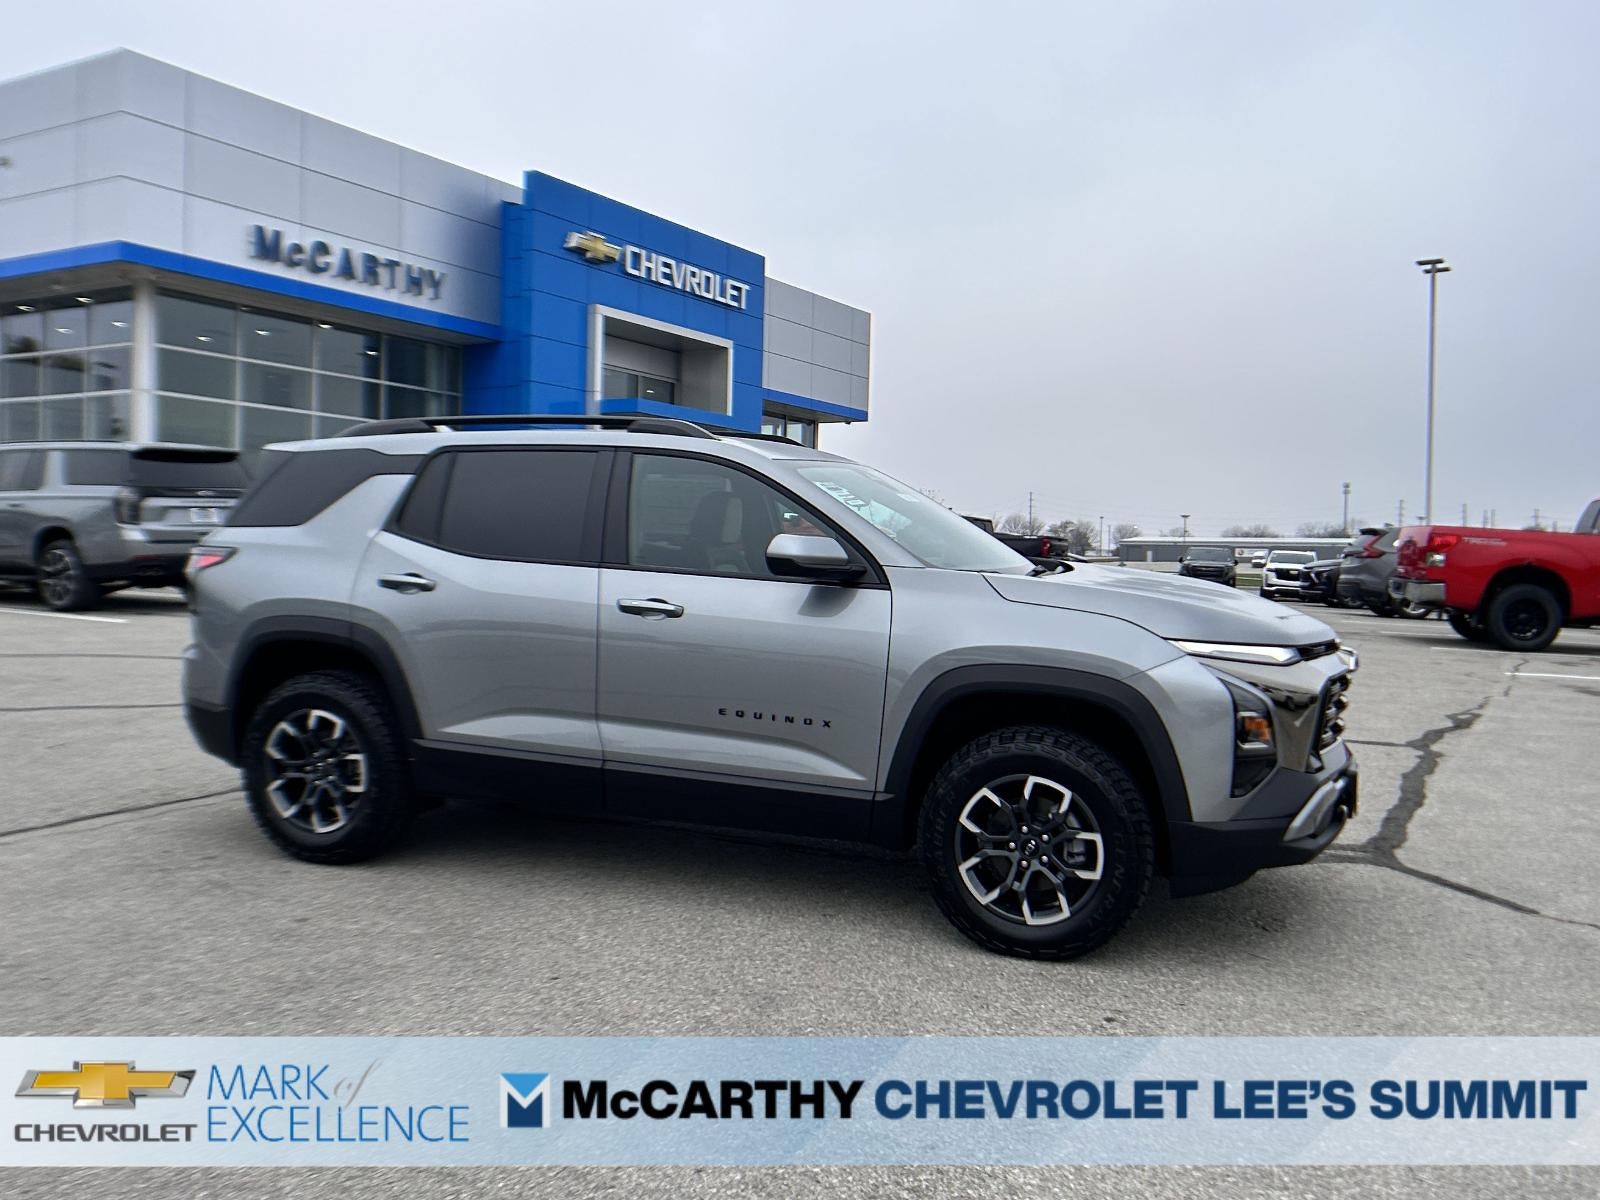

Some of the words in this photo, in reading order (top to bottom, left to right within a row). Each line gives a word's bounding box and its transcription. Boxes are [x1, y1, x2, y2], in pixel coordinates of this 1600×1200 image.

[249, 224, 448, 301] McCARTHY
[624, 244, 751, 310] CHEVROLET
[718, 707, 832, 728] EQUINOX
